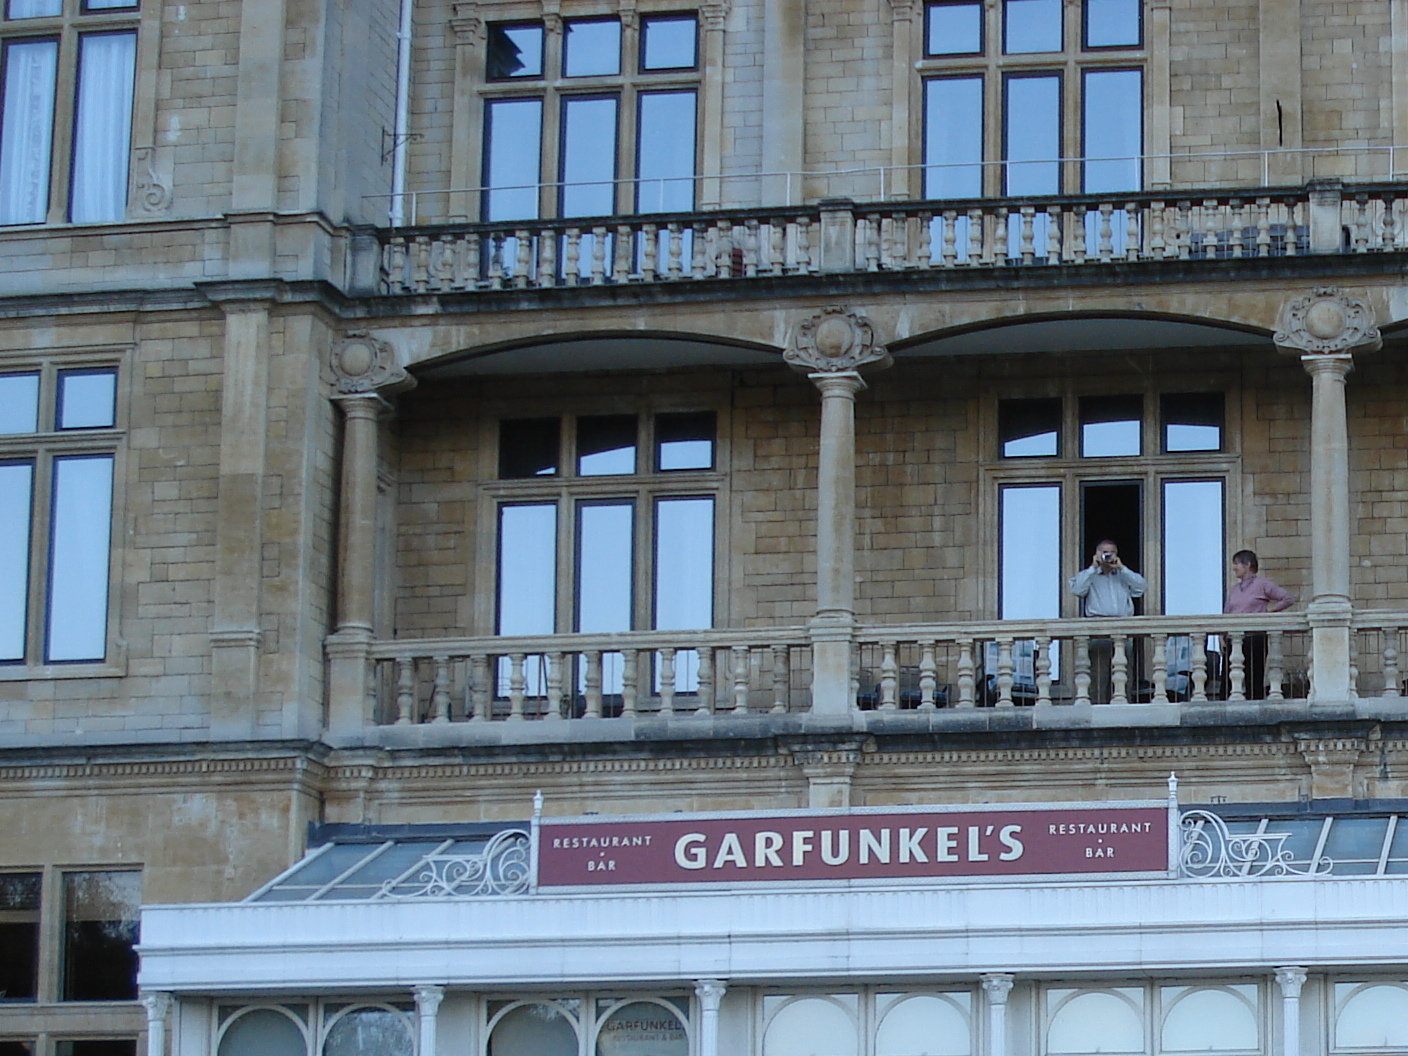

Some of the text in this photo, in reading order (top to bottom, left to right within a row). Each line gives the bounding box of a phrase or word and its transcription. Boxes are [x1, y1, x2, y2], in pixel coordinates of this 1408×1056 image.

[1049, 822, 1151, 835] RESTAURANT
[553, 835, 652, 849] RESTAURANT
[673, 824, 1025, 870] GARFUNKEL'S
[1085, 847, 1115, 858] BAR
[587, 860, 617, 872] BAR
